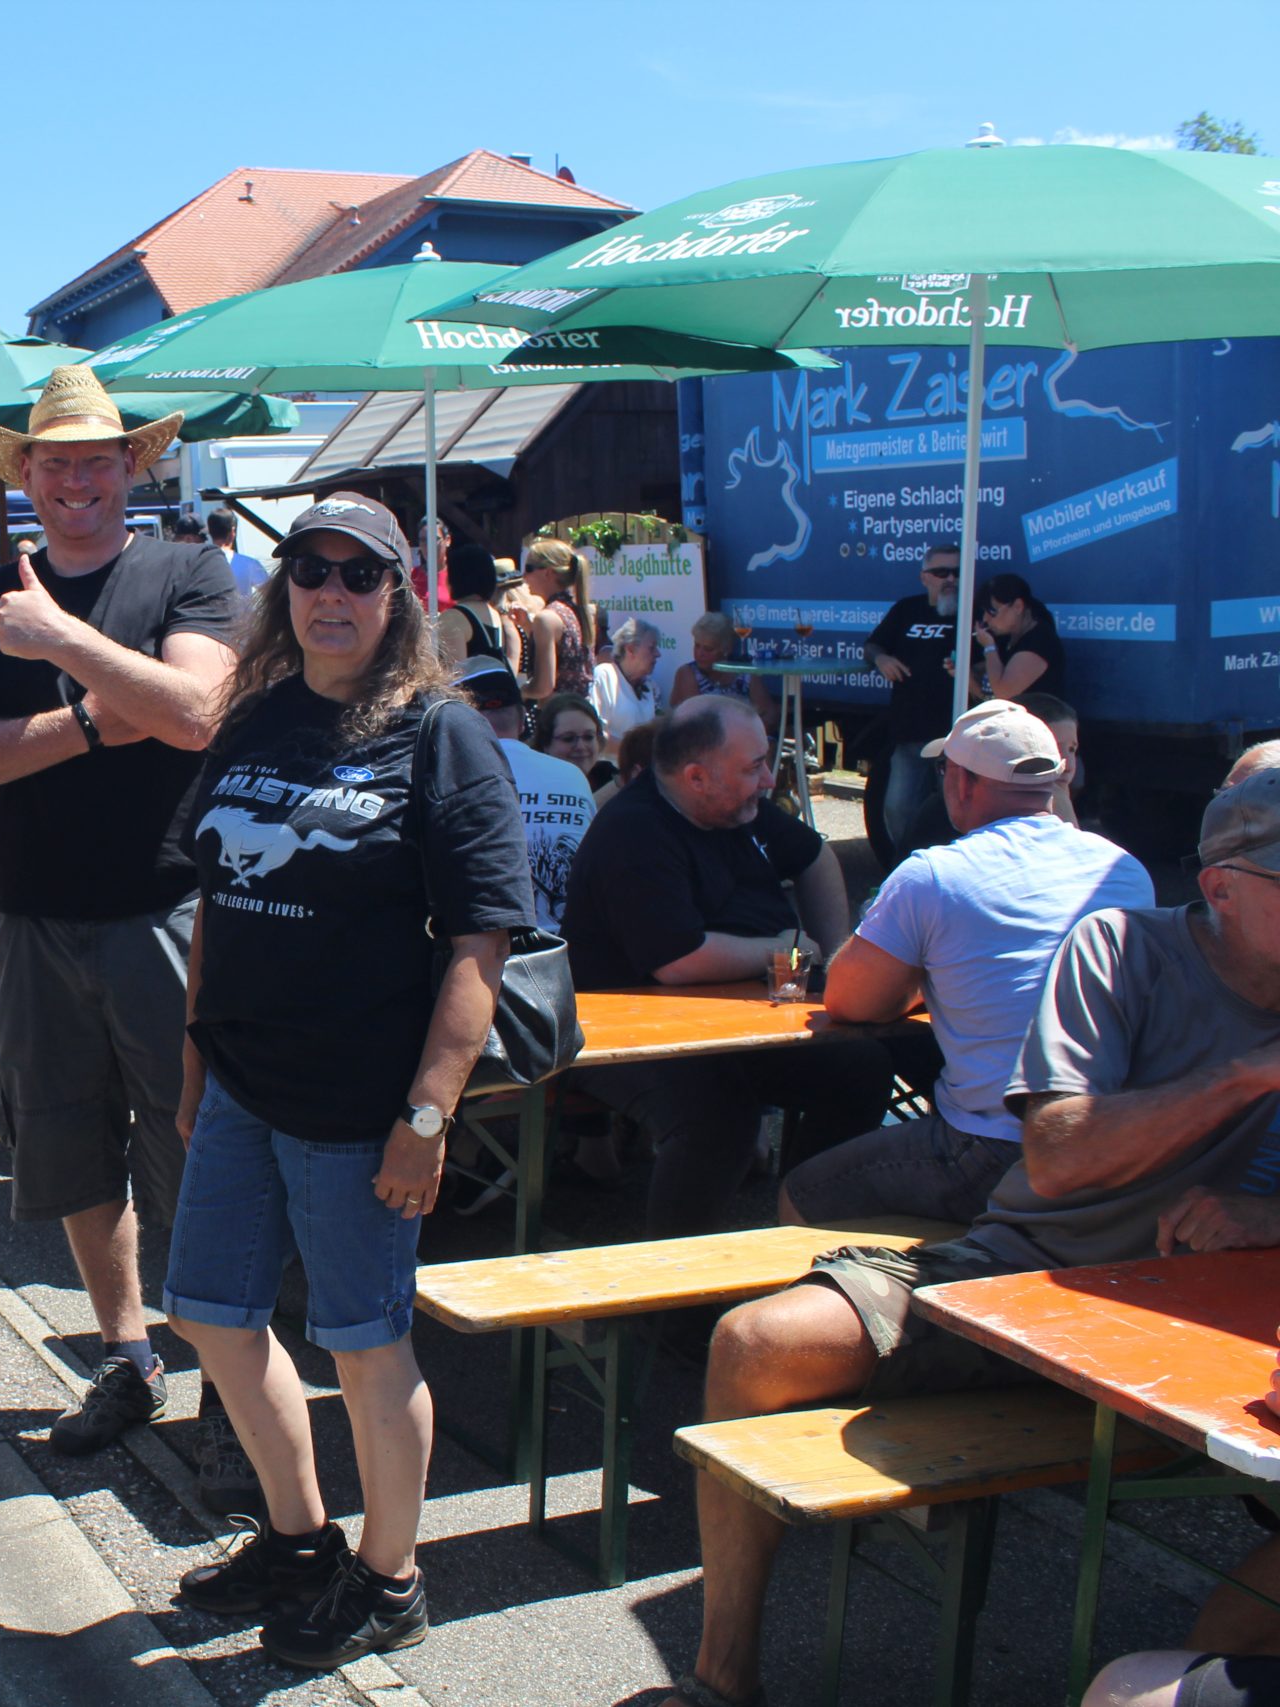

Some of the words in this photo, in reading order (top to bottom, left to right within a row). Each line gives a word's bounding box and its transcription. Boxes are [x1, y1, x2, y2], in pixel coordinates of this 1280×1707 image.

[567, 222, 810, 270] Hochdorfer
[772, 361, 871, 486] Mark
[826, 436, 914, 463] Metzgermeister
[918, 432, 927, 453] &
[932, 425, 1008, 453] Betriewirt
[843, 490, 896, 512] Eigene
[900, 484, 1005, 507] Schlachung
[1027, 500, 1092, 537] Mobiler
[1095, 468, 1167, 511] Verkauf
[1093, 518, 1112, 533] und
[1114, 499, 1171, 526] Umgebung
[863, 513, 963, 537] Partyservice
[1224, 653, 1259, 671] Mark
[211, 775, 386, 819] MUSTANG
[216, 892, 228, 906] THE
[228, 895, 264, 913] LEGEND
[267, 902, 305, 919] LIVES
